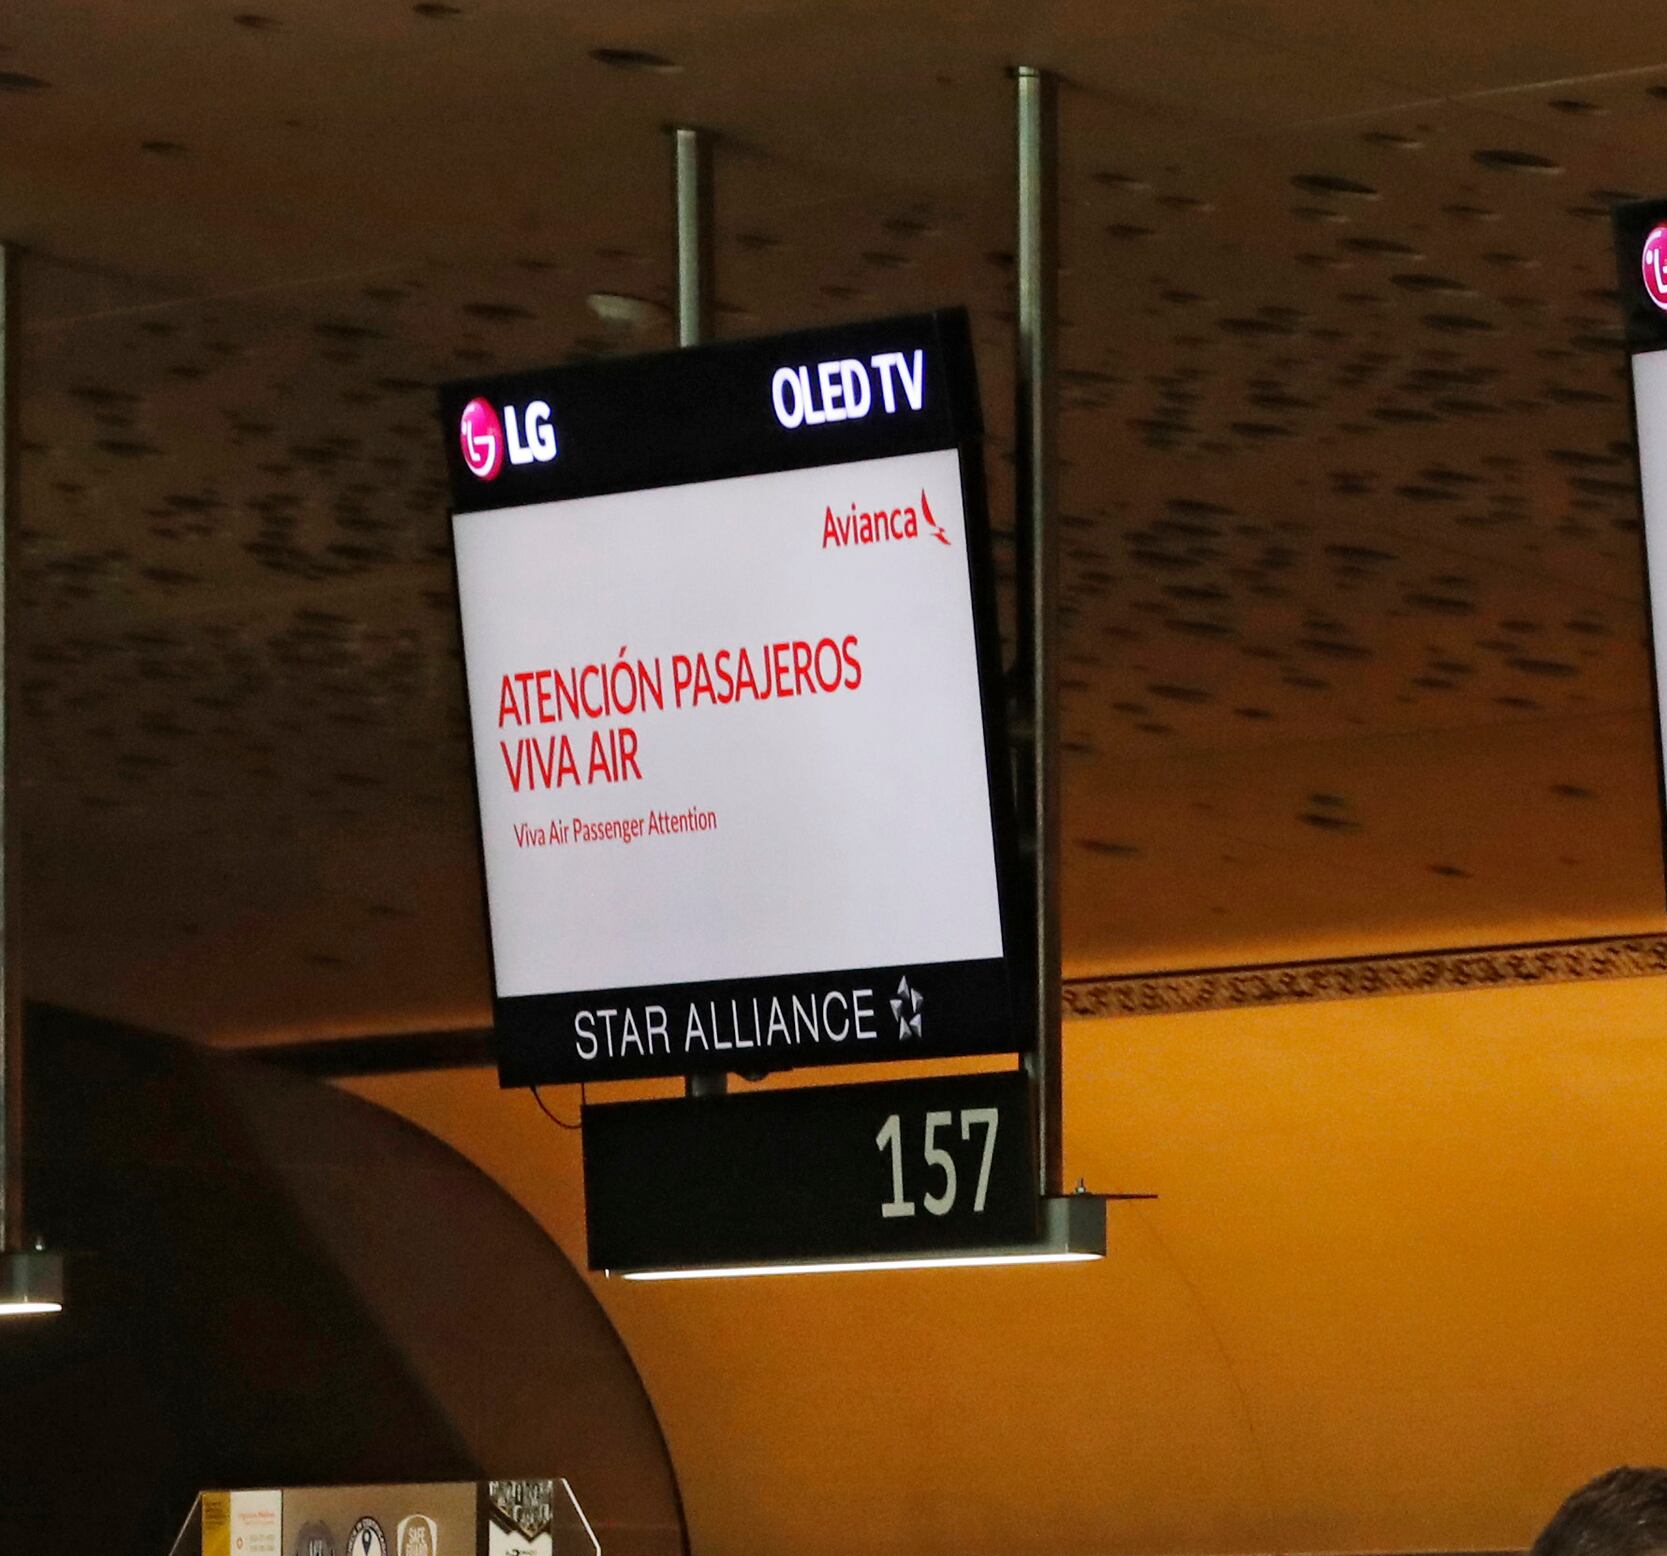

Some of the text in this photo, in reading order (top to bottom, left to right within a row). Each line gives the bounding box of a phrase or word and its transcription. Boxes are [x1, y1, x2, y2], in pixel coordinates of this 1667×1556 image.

[772, 350, 922, 428] OLED TV
[504, 401, 556, 464] LG
[823, 504, 918, 548] Avianca
[499, 635, 862, 727] ATENCIÓN PASAJEROS
[500, 727, 642, 793] VIVA AIR
[514, 807, 717, 848] Viva Air Passenger Attention
[575, 990, 876, 1059] STAR ALLIANCE
[877, 1109, 998, 1217] 157
